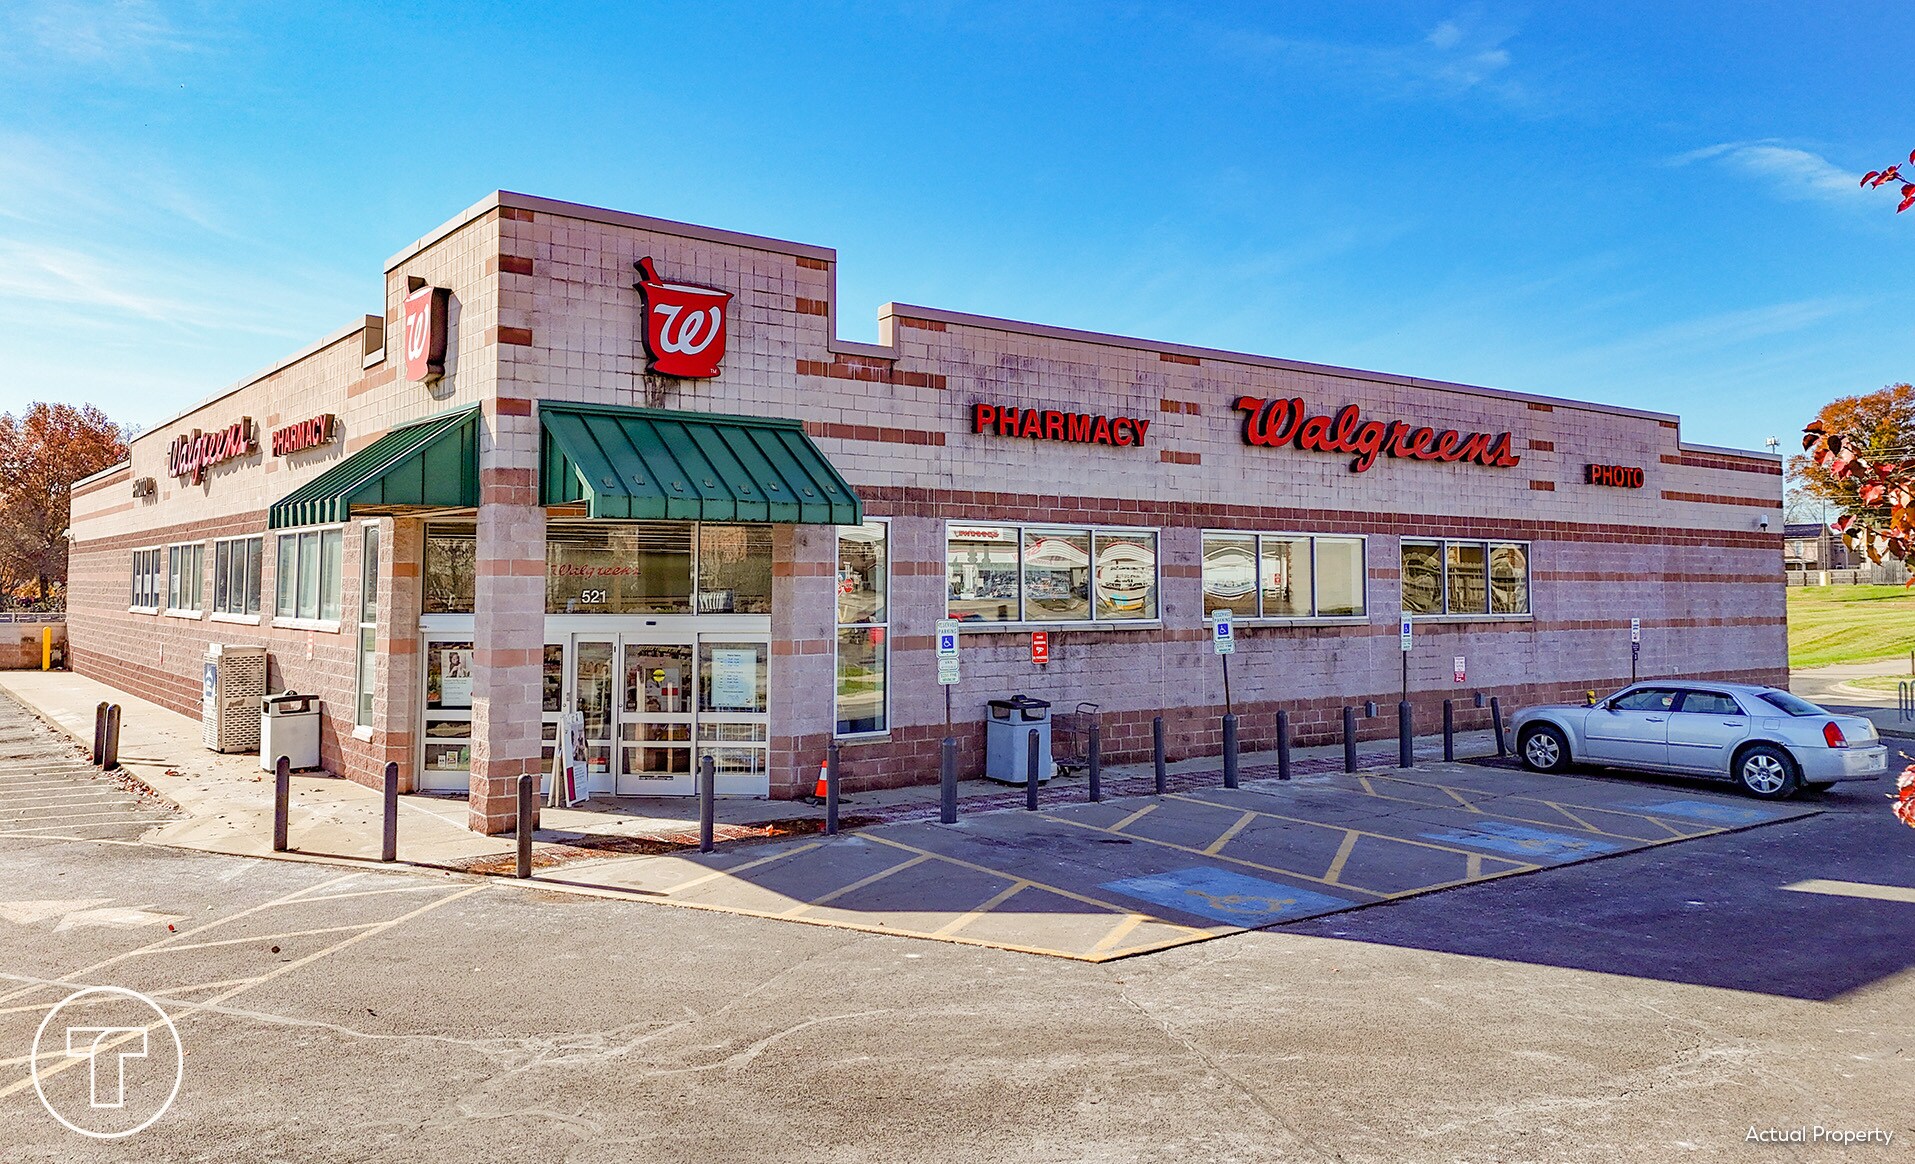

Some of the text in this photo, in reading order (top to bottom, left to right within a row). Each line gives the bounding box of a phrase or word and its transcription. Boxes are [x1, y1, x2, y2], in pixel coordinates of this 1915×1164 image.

[406, 303, 429, 361] W
[653, 303, 721, 355] W
[272, 413, 327, 458] PHARMACY
[974, 402, 1151, 447] PHARMACY
[1235, 395, 1521, 473] Walgreens
[167, 415, 253, 486] Walgreens
[1591, 463, 1645, 489] PHOTO
[551, 564, 641, 580] Walgreens
[581, 589, 607, 604] 521
